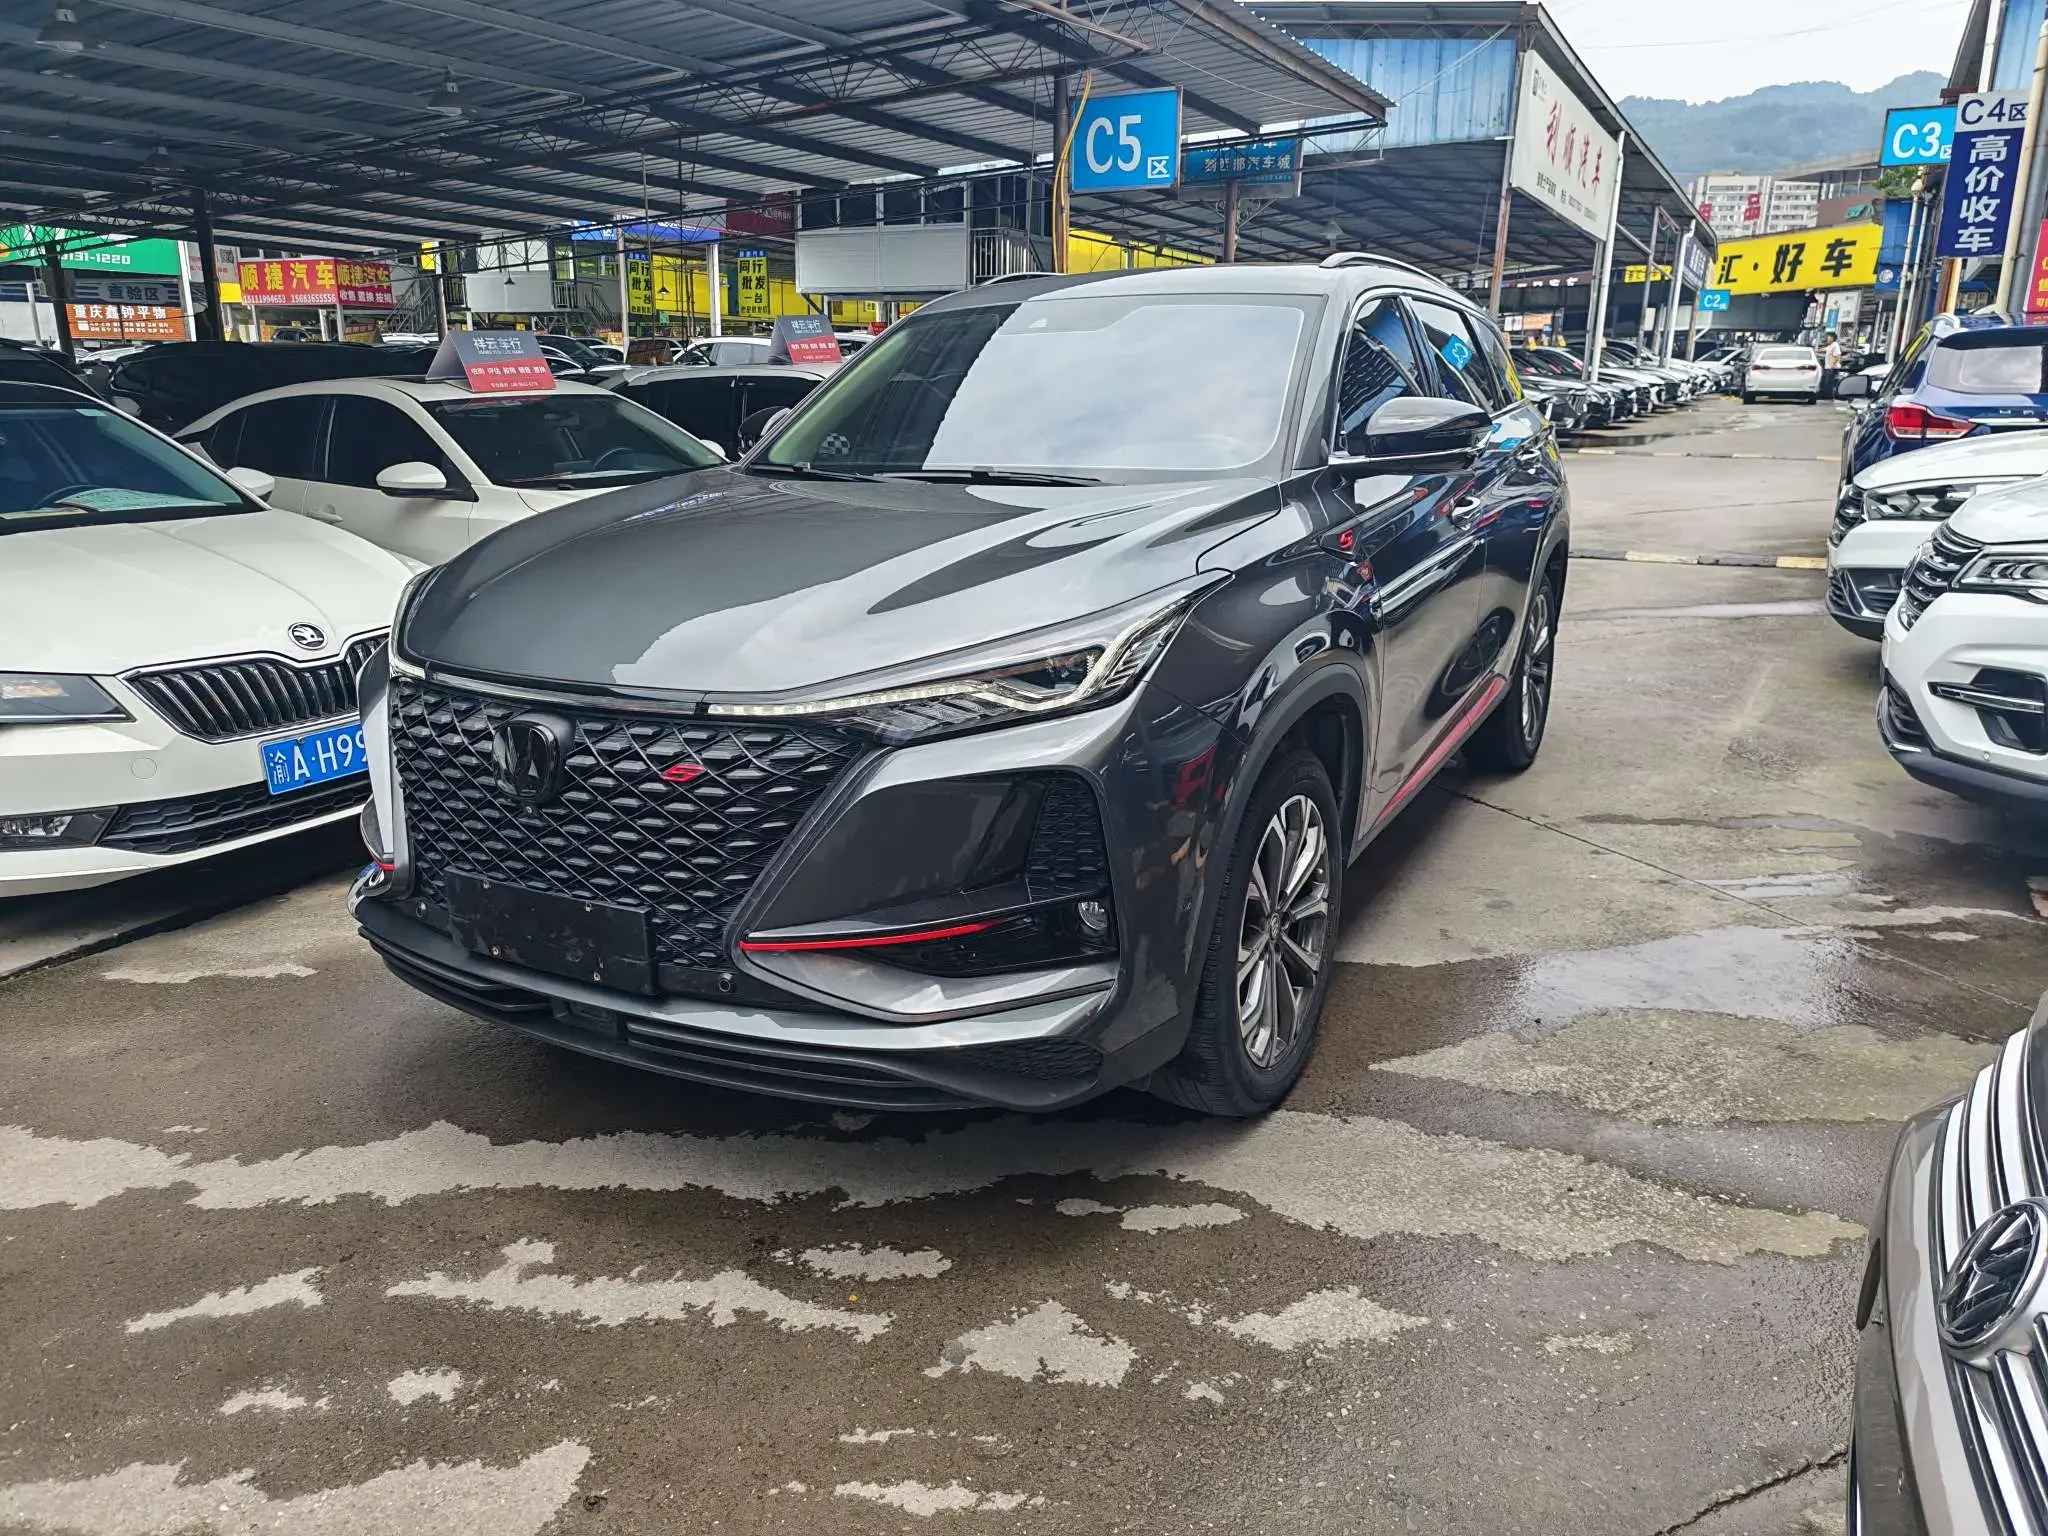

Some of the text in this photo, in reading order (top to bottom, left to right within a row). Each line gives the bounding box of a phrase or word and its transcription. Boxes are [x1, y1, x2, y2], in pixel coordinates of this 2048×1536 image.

[1961, 97, 2028, 125] C4区
[1955, 134, 2011, 252] 高价收车
[739, 259, 763, 274] 同行
[239, 261, 336, 290] 顺捷汽车
[742, 275, 765, 290] 批发
[107, 284, 160, 301] 查验区
[744, 292, 763, 304] 一台
[473, 337, 521, 350] 祥云车行
